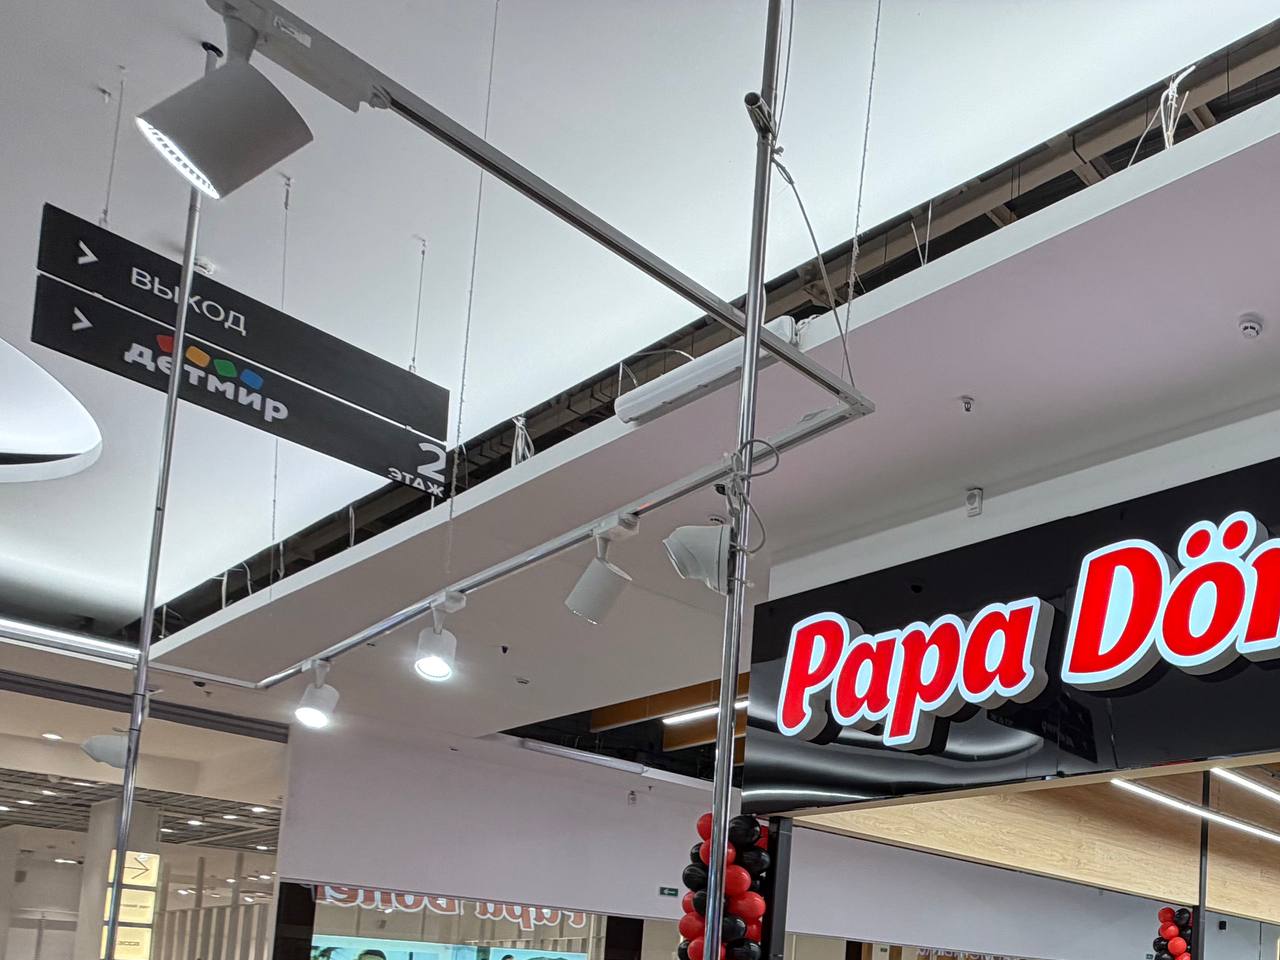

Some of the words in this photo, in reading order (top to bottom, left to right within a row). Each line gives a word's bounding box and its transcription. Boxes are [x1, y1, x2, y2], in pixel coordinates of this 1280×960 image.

[387, 467, 445, 498] ЭТАЖ
[417, 442, 447, 483] 2
[776, 596, 1046, 746] Papa
